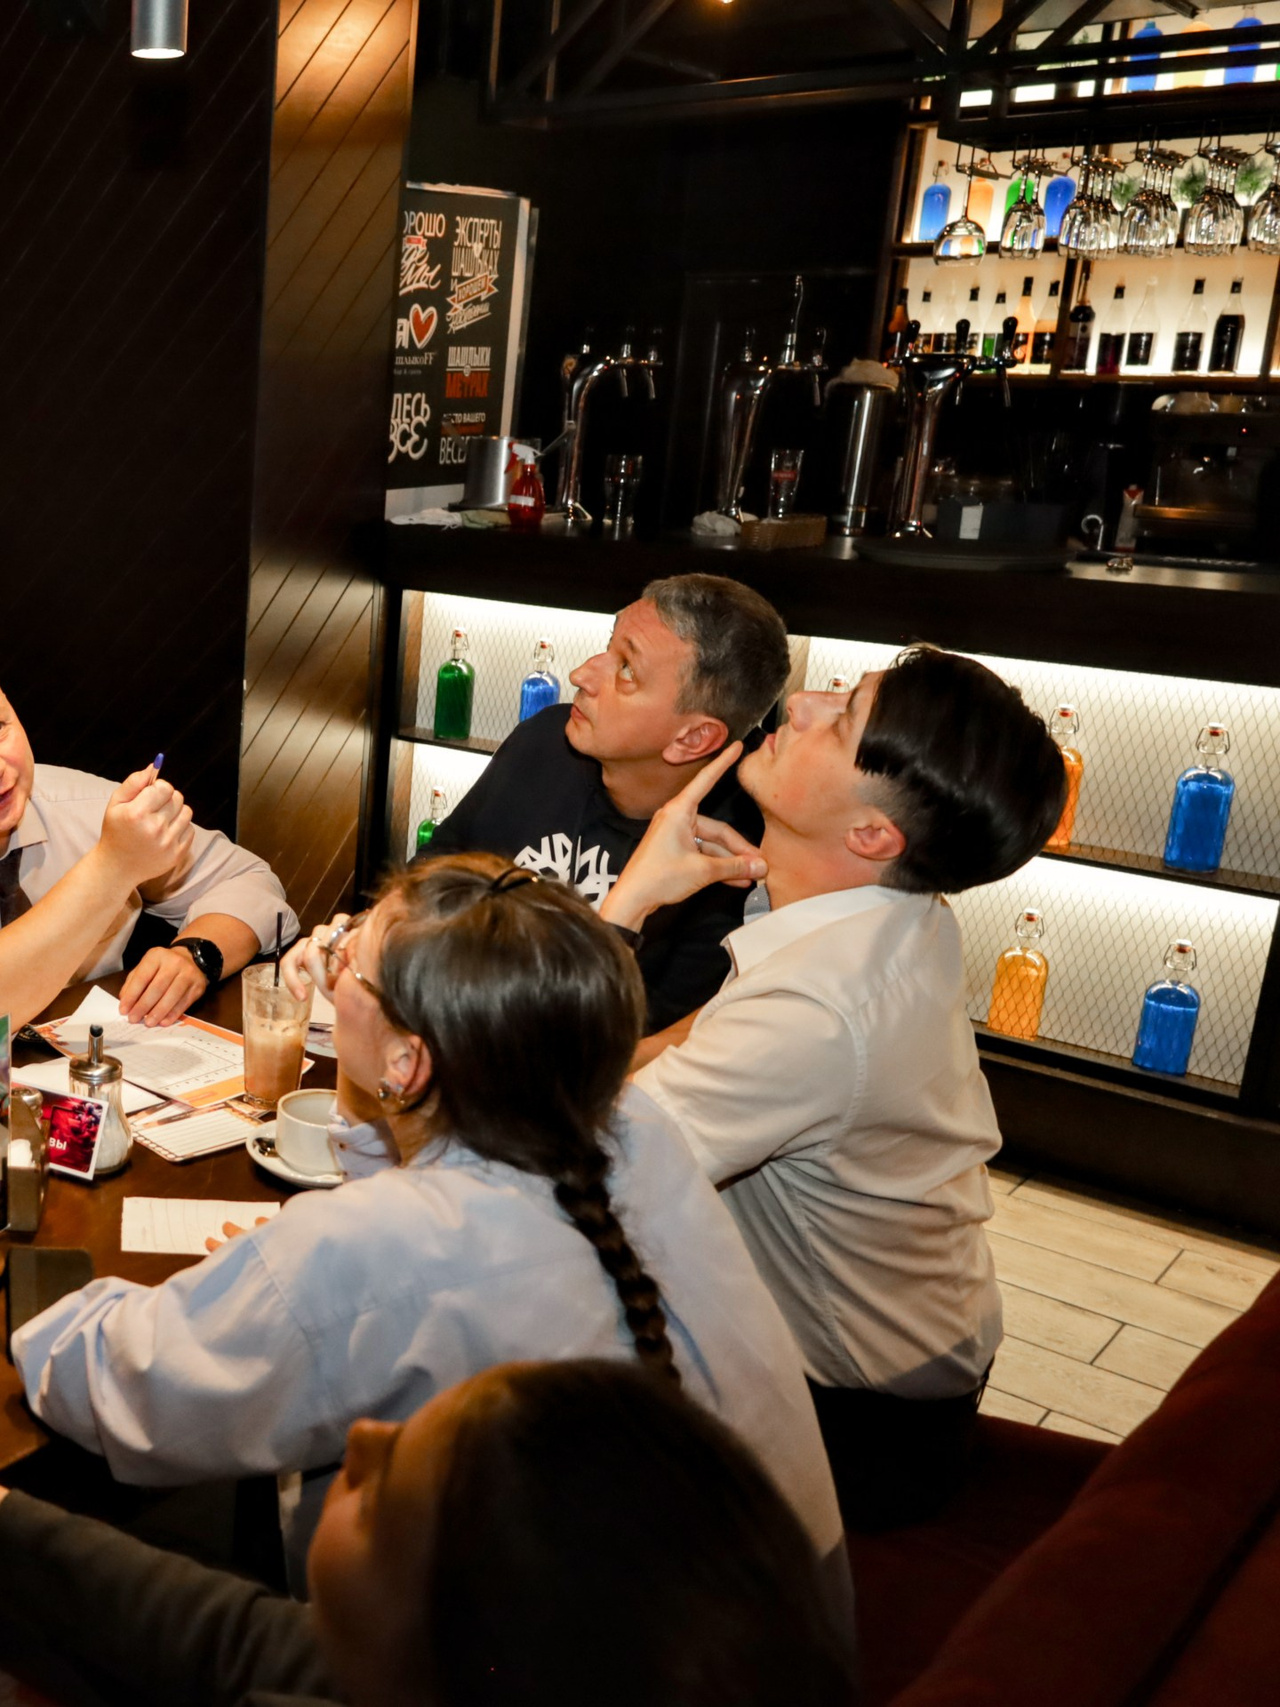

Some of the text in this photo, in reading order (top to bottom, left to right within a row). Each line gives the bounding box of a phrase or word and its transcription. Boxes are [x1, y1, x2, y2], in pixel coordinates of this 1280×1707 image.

[454, 215, 503, 249] ЭКСПЕРТЫ
[447, 346, 492, 368] ШАШЛЫКИ
[445, 372, 489, 399] МЕТРАХ
